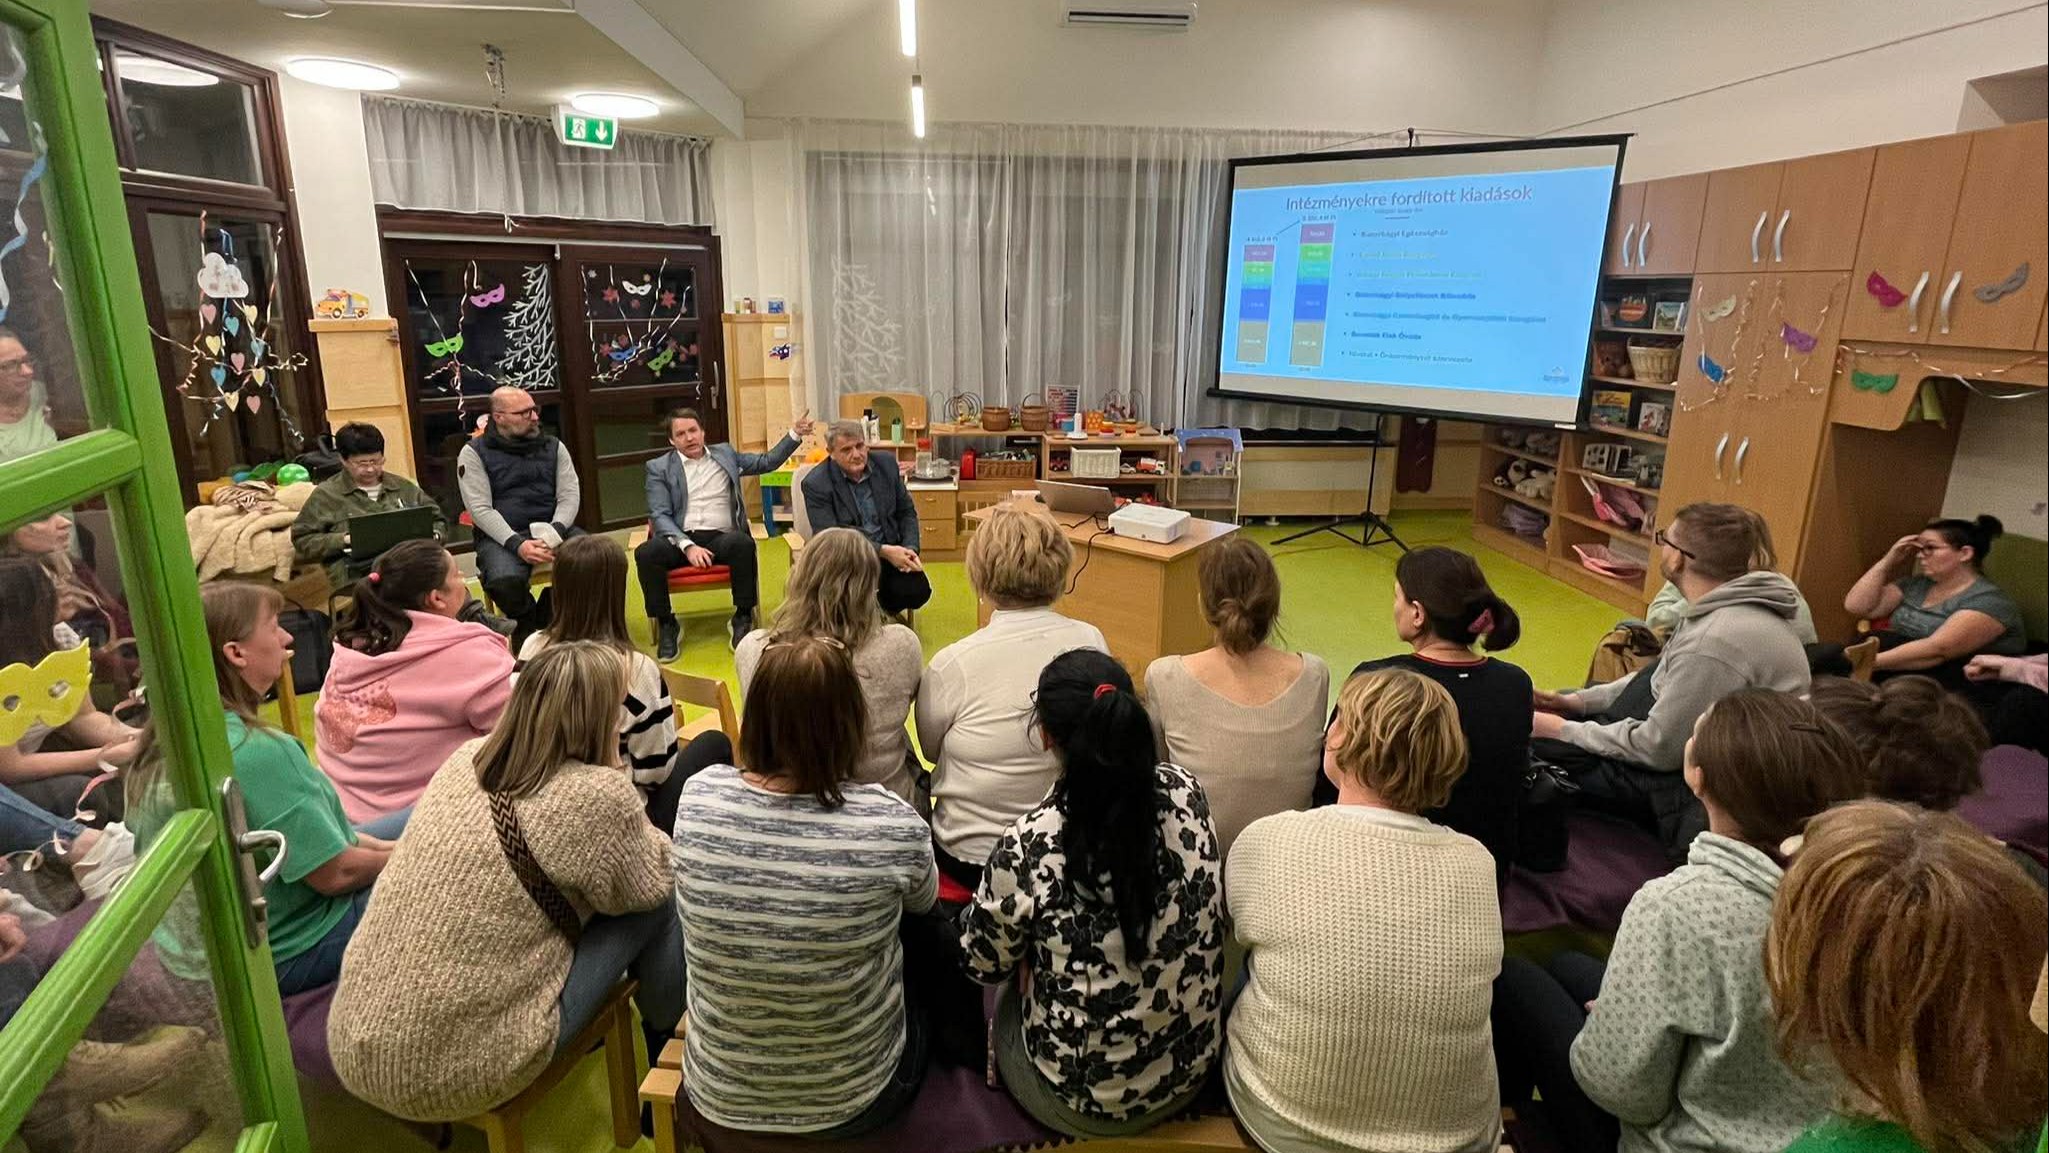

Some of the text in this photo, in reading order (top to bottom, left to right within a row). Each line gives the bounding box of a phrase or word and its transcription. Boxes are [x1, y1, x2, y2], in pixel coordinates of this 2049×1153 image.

[1286, 193, 1387, 211] Intézményekre
[1391, 189, 1456, 207] fordított
[1460, 185, 1533, 202] kiadások
